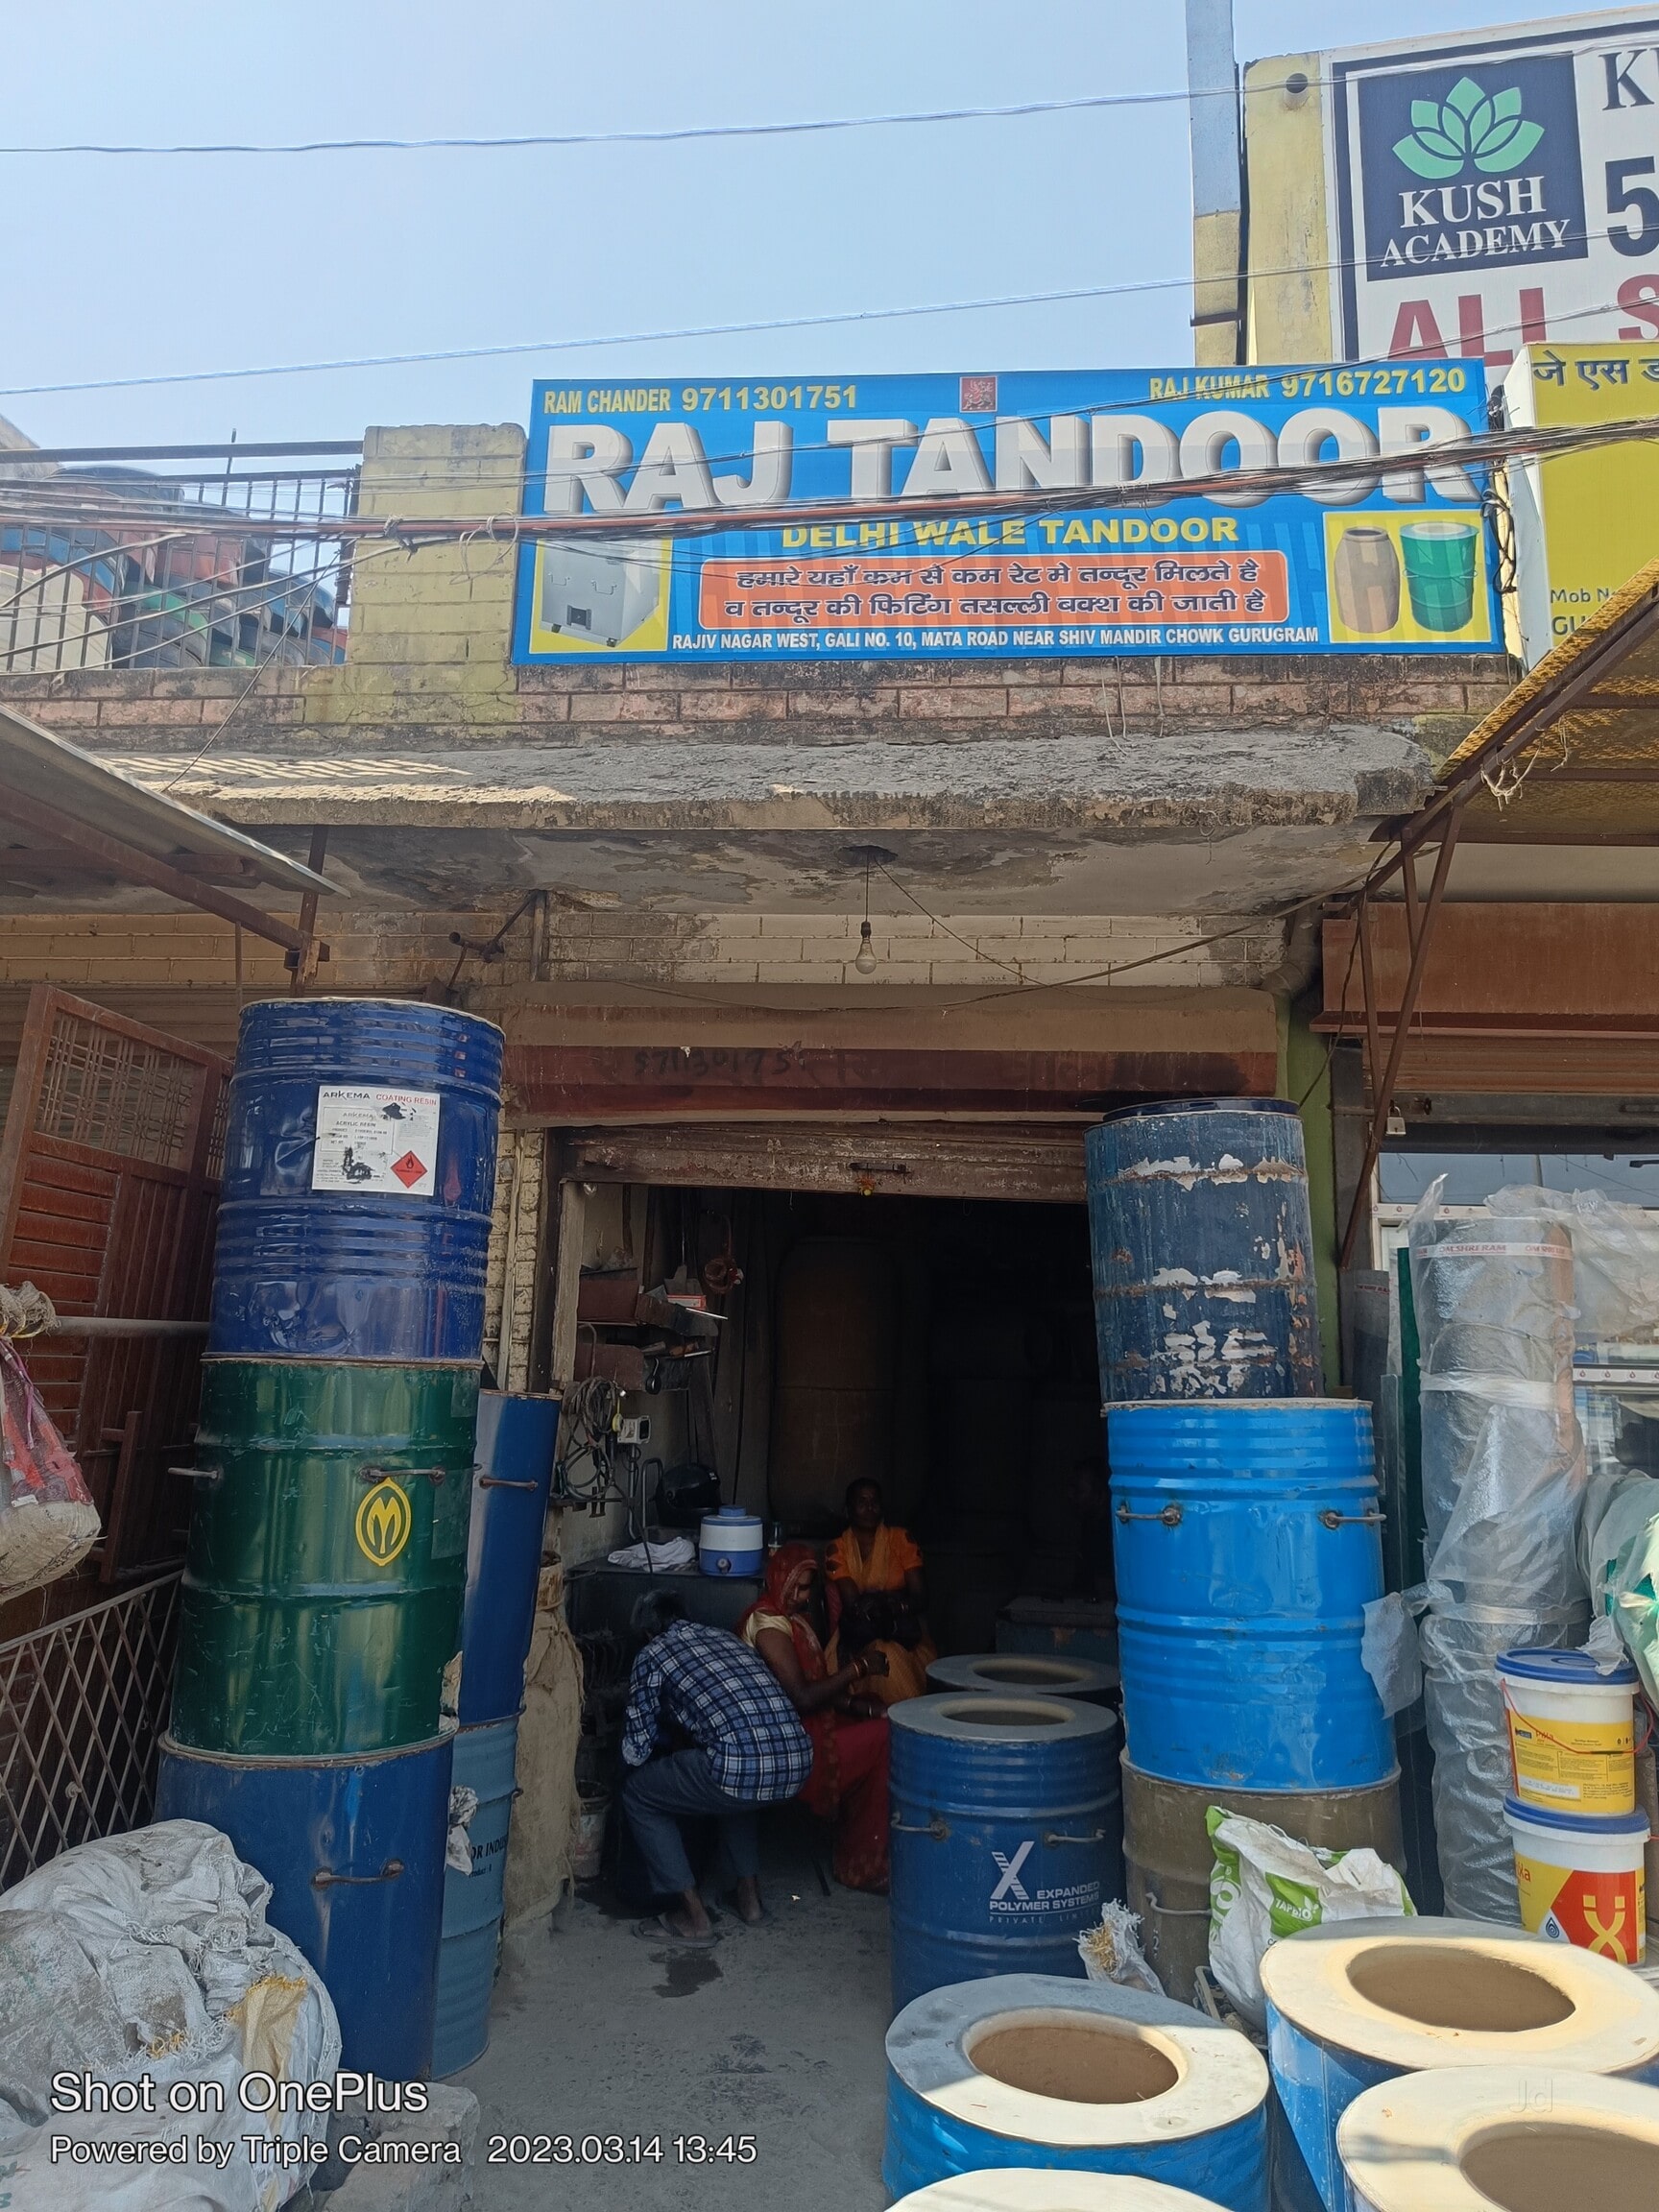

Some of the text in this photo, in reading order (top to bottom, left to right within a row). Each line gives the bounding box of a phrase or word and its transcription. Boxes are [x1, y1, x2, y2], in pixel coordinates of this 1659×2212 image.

[1399, 176, 1547, 228] KUSH
[1380, 220, 1571, 268] ACADEMY
[1150, 368, 1466, 401] RAJ KUMAR 9716727120
[1531, 349, 1566, 386] जे
[1575, 359, 1629, 391] एस
[543, 384, 857, 414] RAM CHANDER 9711301751
[543, 406, 1484, 517] RAJ TANDOOR
[782, 517, 1238, 548] DELHI WALE TANDOOR
[736, 558, 1259, 589] हमारे यहाँ कम से कम रेट मे तन्दूर मिलते है
[724, 600, 745, 617] व
[752, 599, 821, 624] तन्दूर
[826, 592, 862, 616] की
[869, 591, 952, 615] फिटिंग
[959, 589, 1050, 615] तसल्ली
[1128, 589, 1165, 613] की
[1171, 588, 1239, 613] जाती
[1245, 587, 1265, 613] है
[1551, 588, 1591, 604] Mob
[672, 627, 1318, 651] RAJIV NAGAR WEST, GALI NO. 10, MATA ROAD NEAR SHIV MANDIR CHOWK GURUGRAM
[323, 1090, 437, 1106] ARKEMA COATING RESIN
[990, 1891, 1099, 1911] POLYMER SYSTEMS
[1037, 1881, 1099, 1900] EXPANDED
[989, 1915, 1044, 1924] PRIVATE
